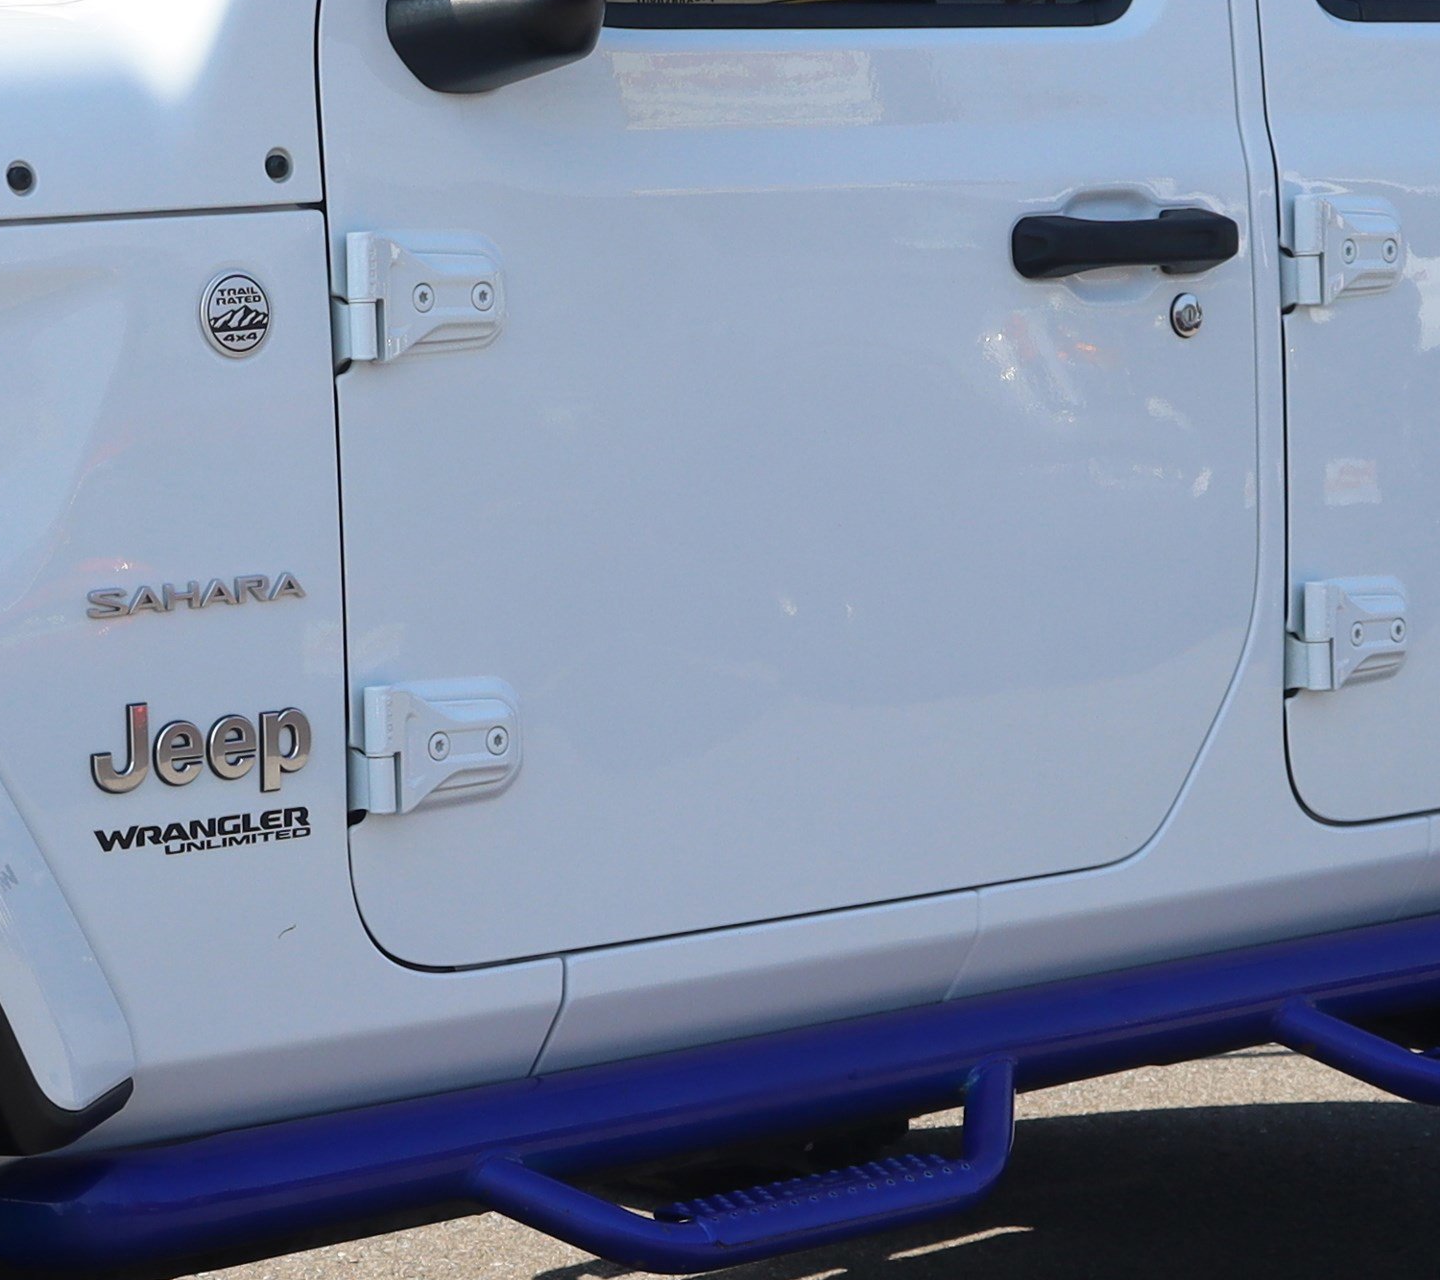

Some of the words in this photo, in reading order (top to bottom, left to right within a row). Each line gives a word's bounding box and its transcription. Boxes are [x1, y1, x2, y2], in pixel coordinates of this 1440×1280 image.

[216, 295, 261, 306] RATED
[218, 287, 258, 297] TRAIL
[86, 571, 307, 619] SAHARA
[90, 701, 312, 794] Jeep
[93, 806, 312, 852] WRANGLER
[165, 827, 312, 855] UNLIMITED
